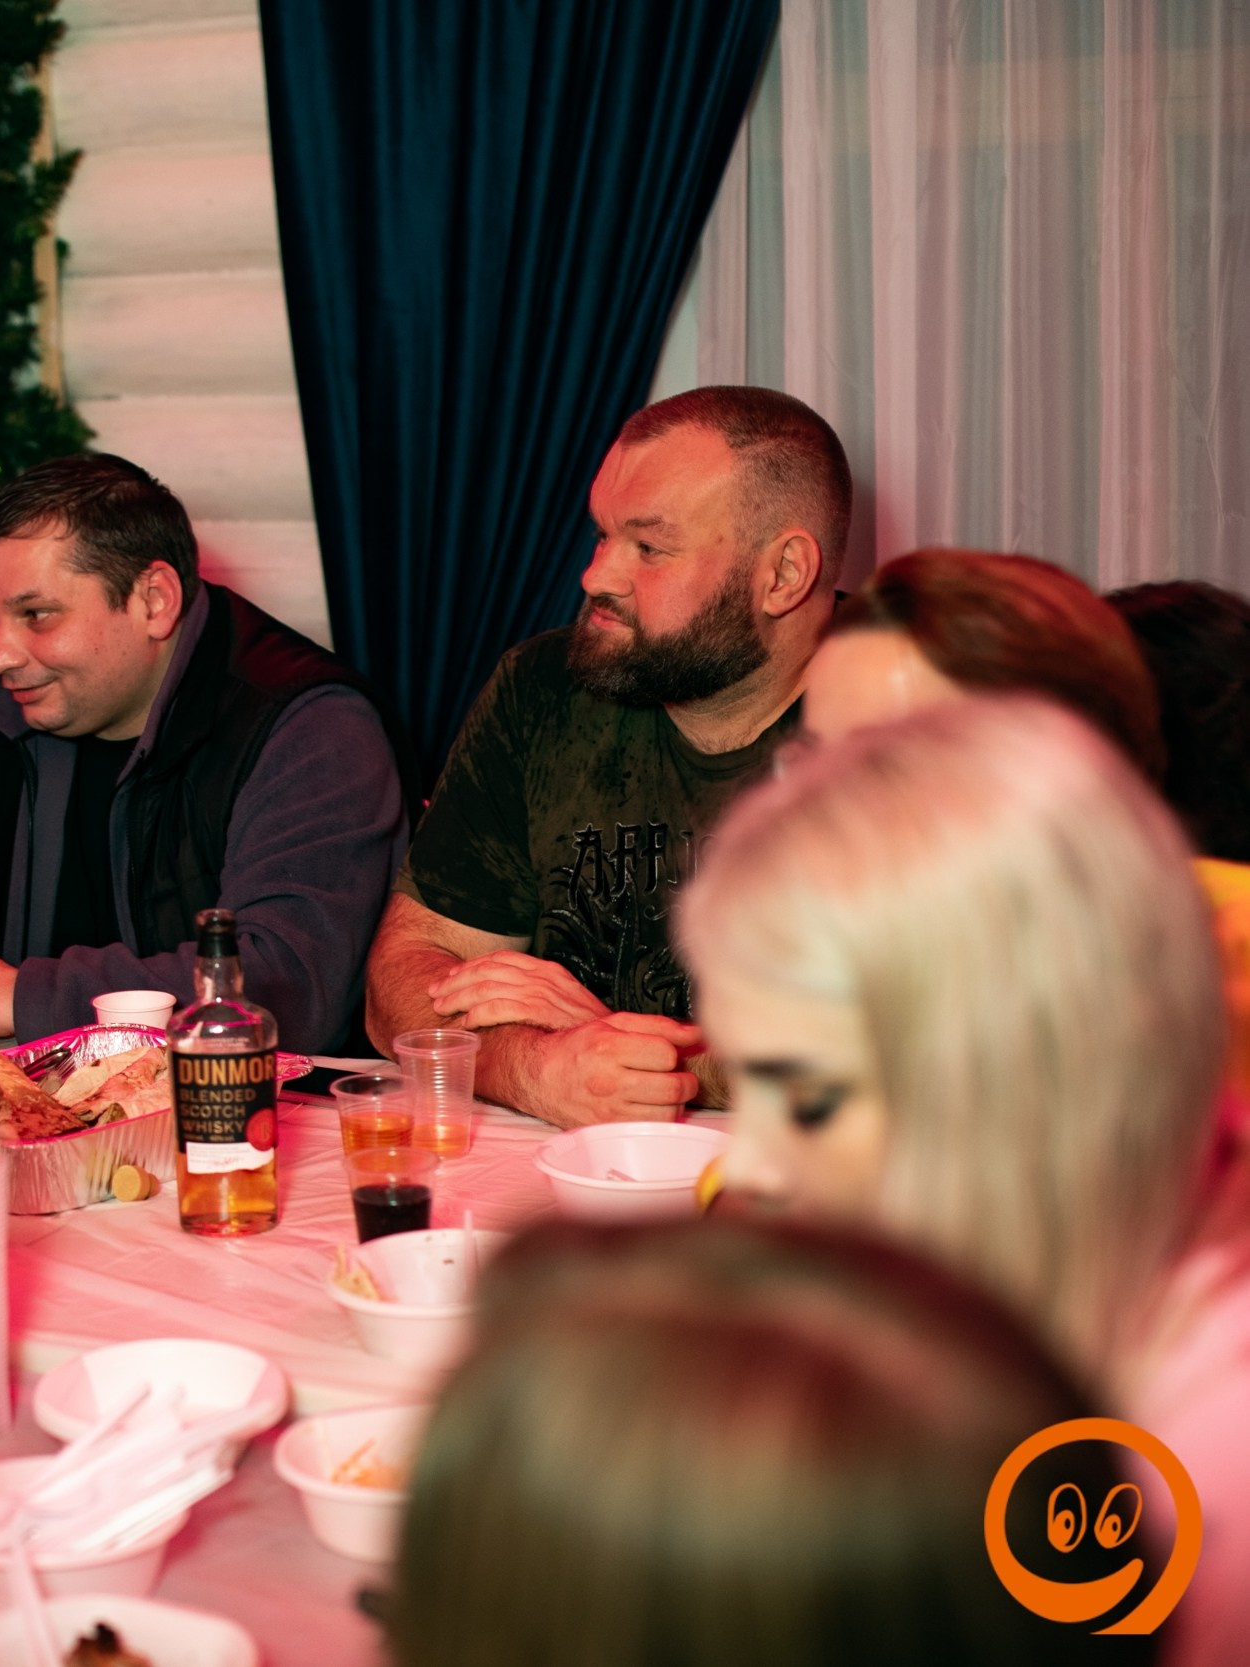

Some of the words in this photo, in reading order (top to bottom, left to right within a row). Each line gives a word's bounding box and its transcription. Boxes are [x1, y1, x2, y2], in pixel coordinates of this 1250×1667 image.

[179, 1088, 256, 1102] BLENDED
[180, 1104, 245, 1118] SCOTCH
[182, 1119, 244, 1134] WHISKY
